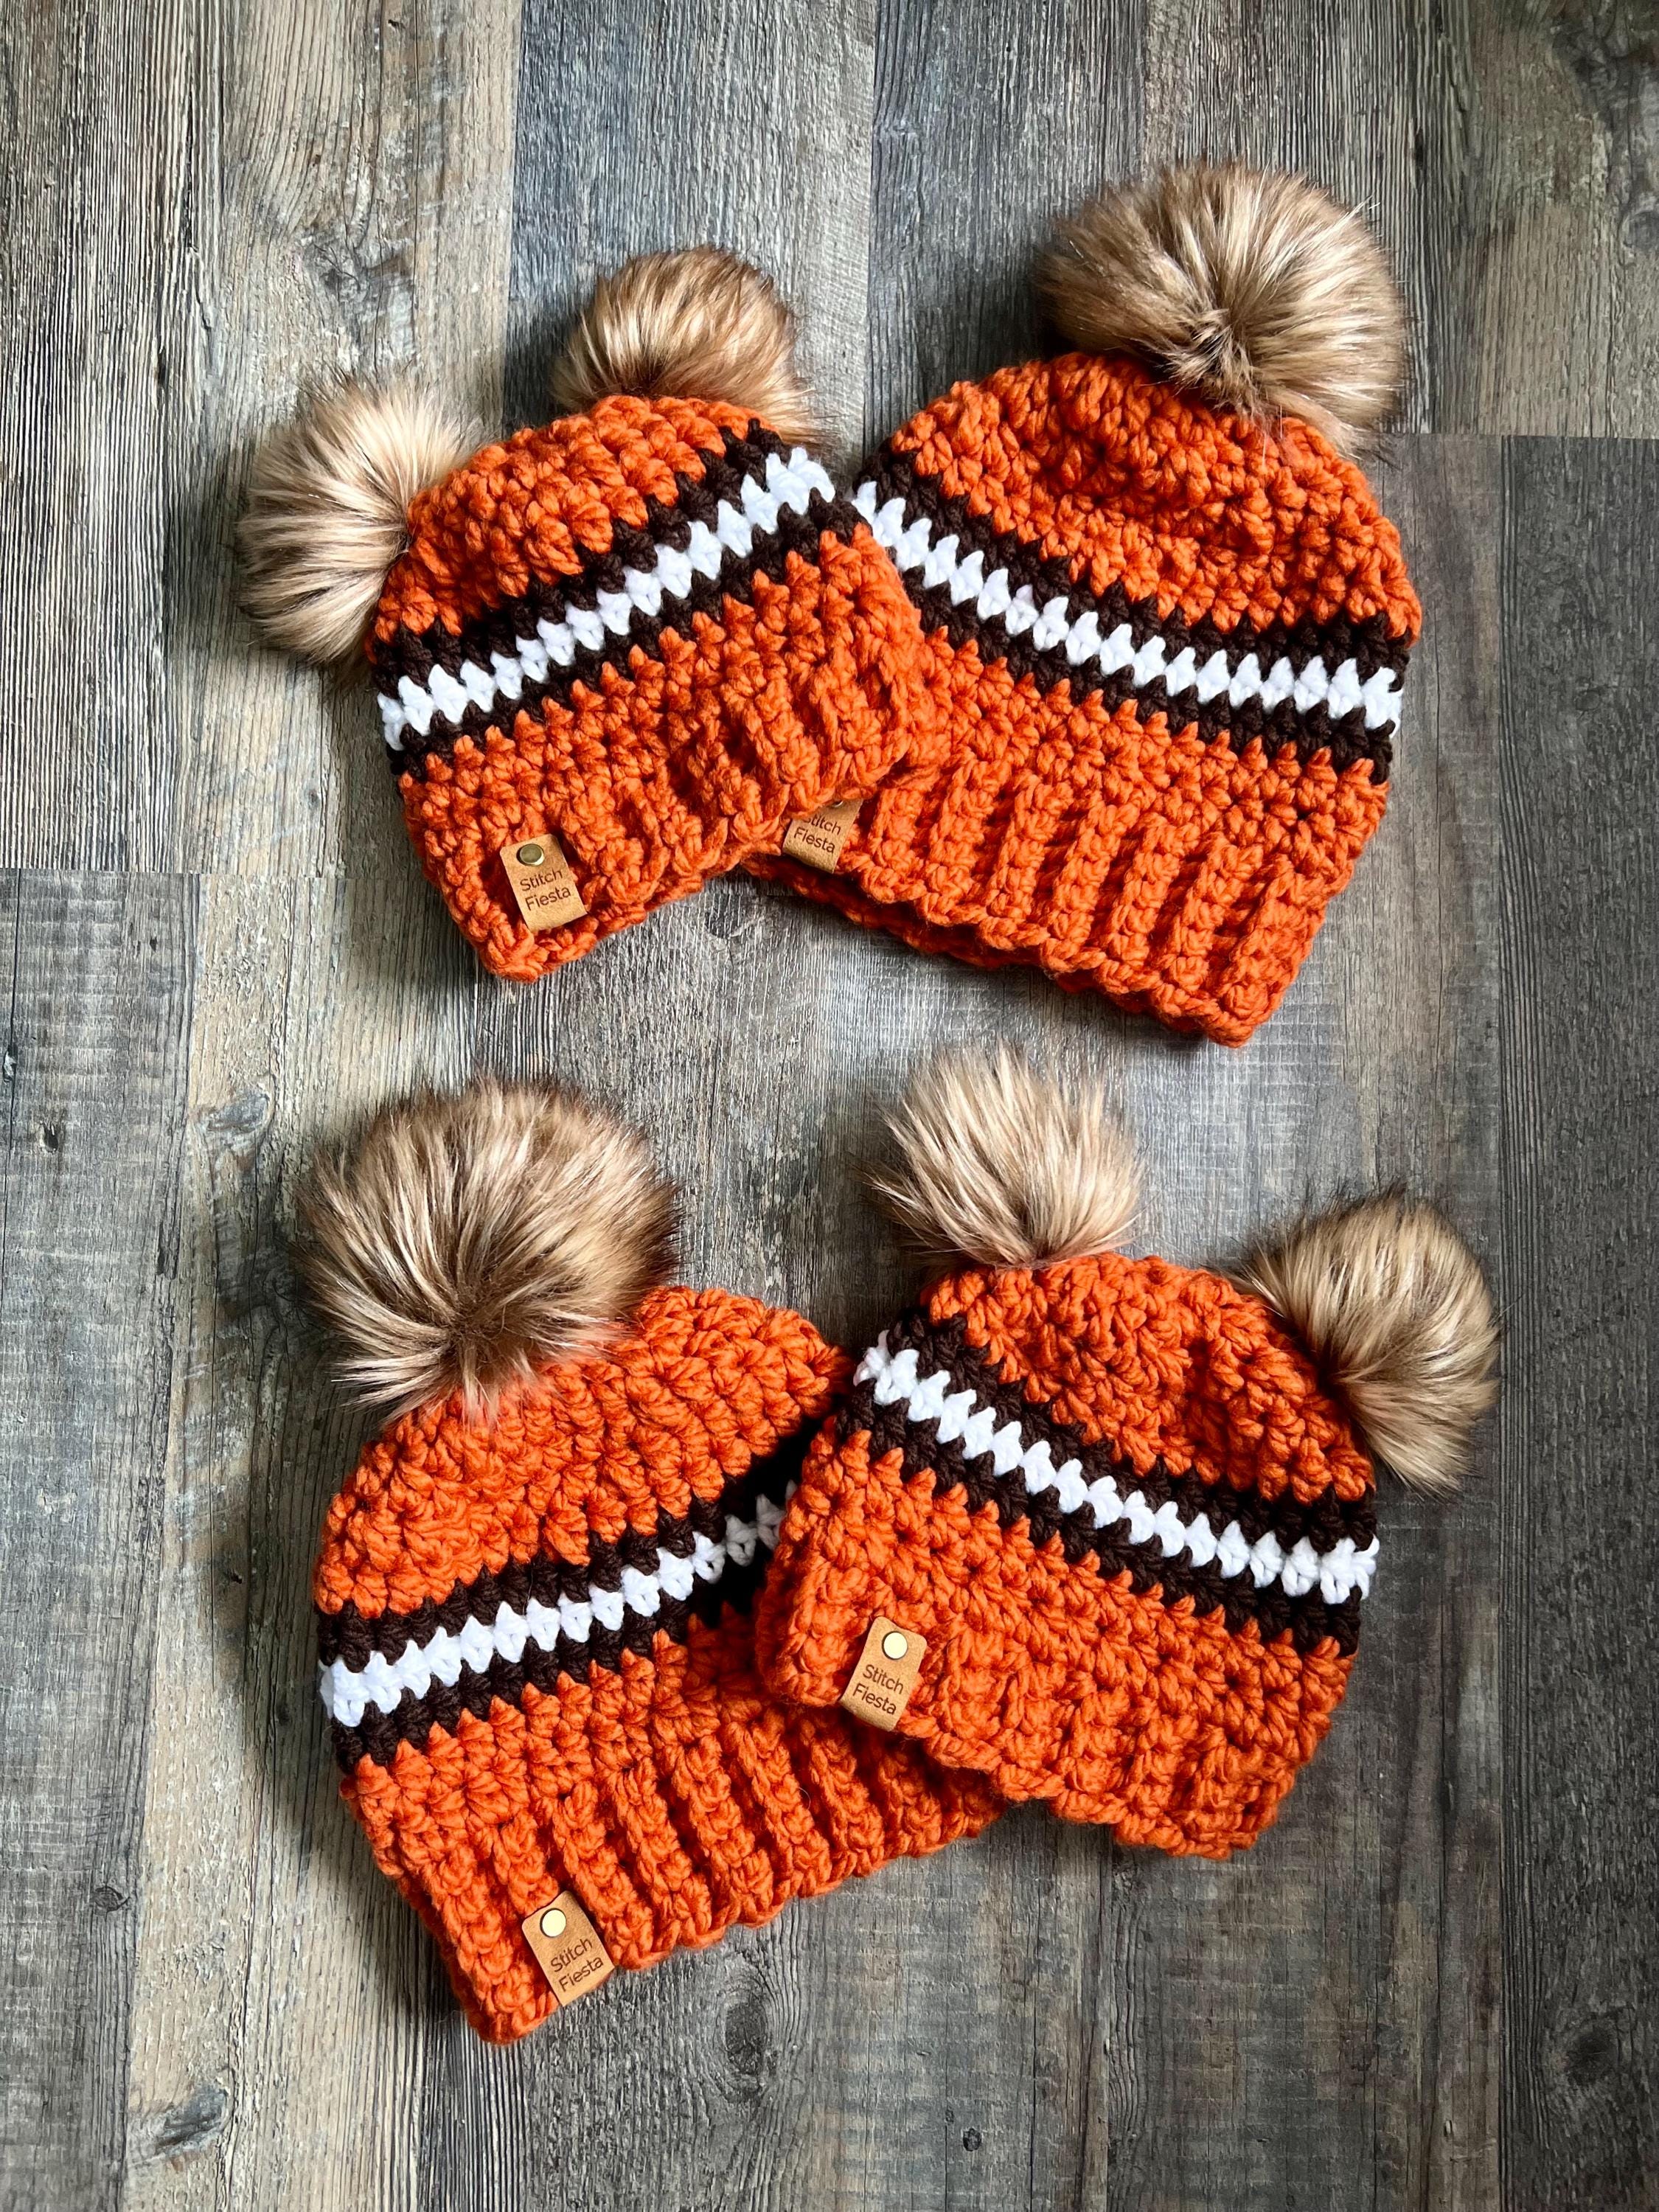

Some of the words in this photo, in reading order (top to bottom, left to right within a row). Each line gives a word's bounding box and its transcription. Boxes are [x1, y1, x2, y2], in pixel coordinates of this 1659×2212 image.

[793, 827, 835, 854] Fiesta
[520, 869, 563, 891] Stitch
[525, 886, 571, 911] Fiesta
[863, 1664, 904, 1694] Stitch
[852, 1683, 897, 1715] Fiesta
[550, 1938, 593, 1972] Stitch
[558, 1957, 604, 1992] Fiesta
